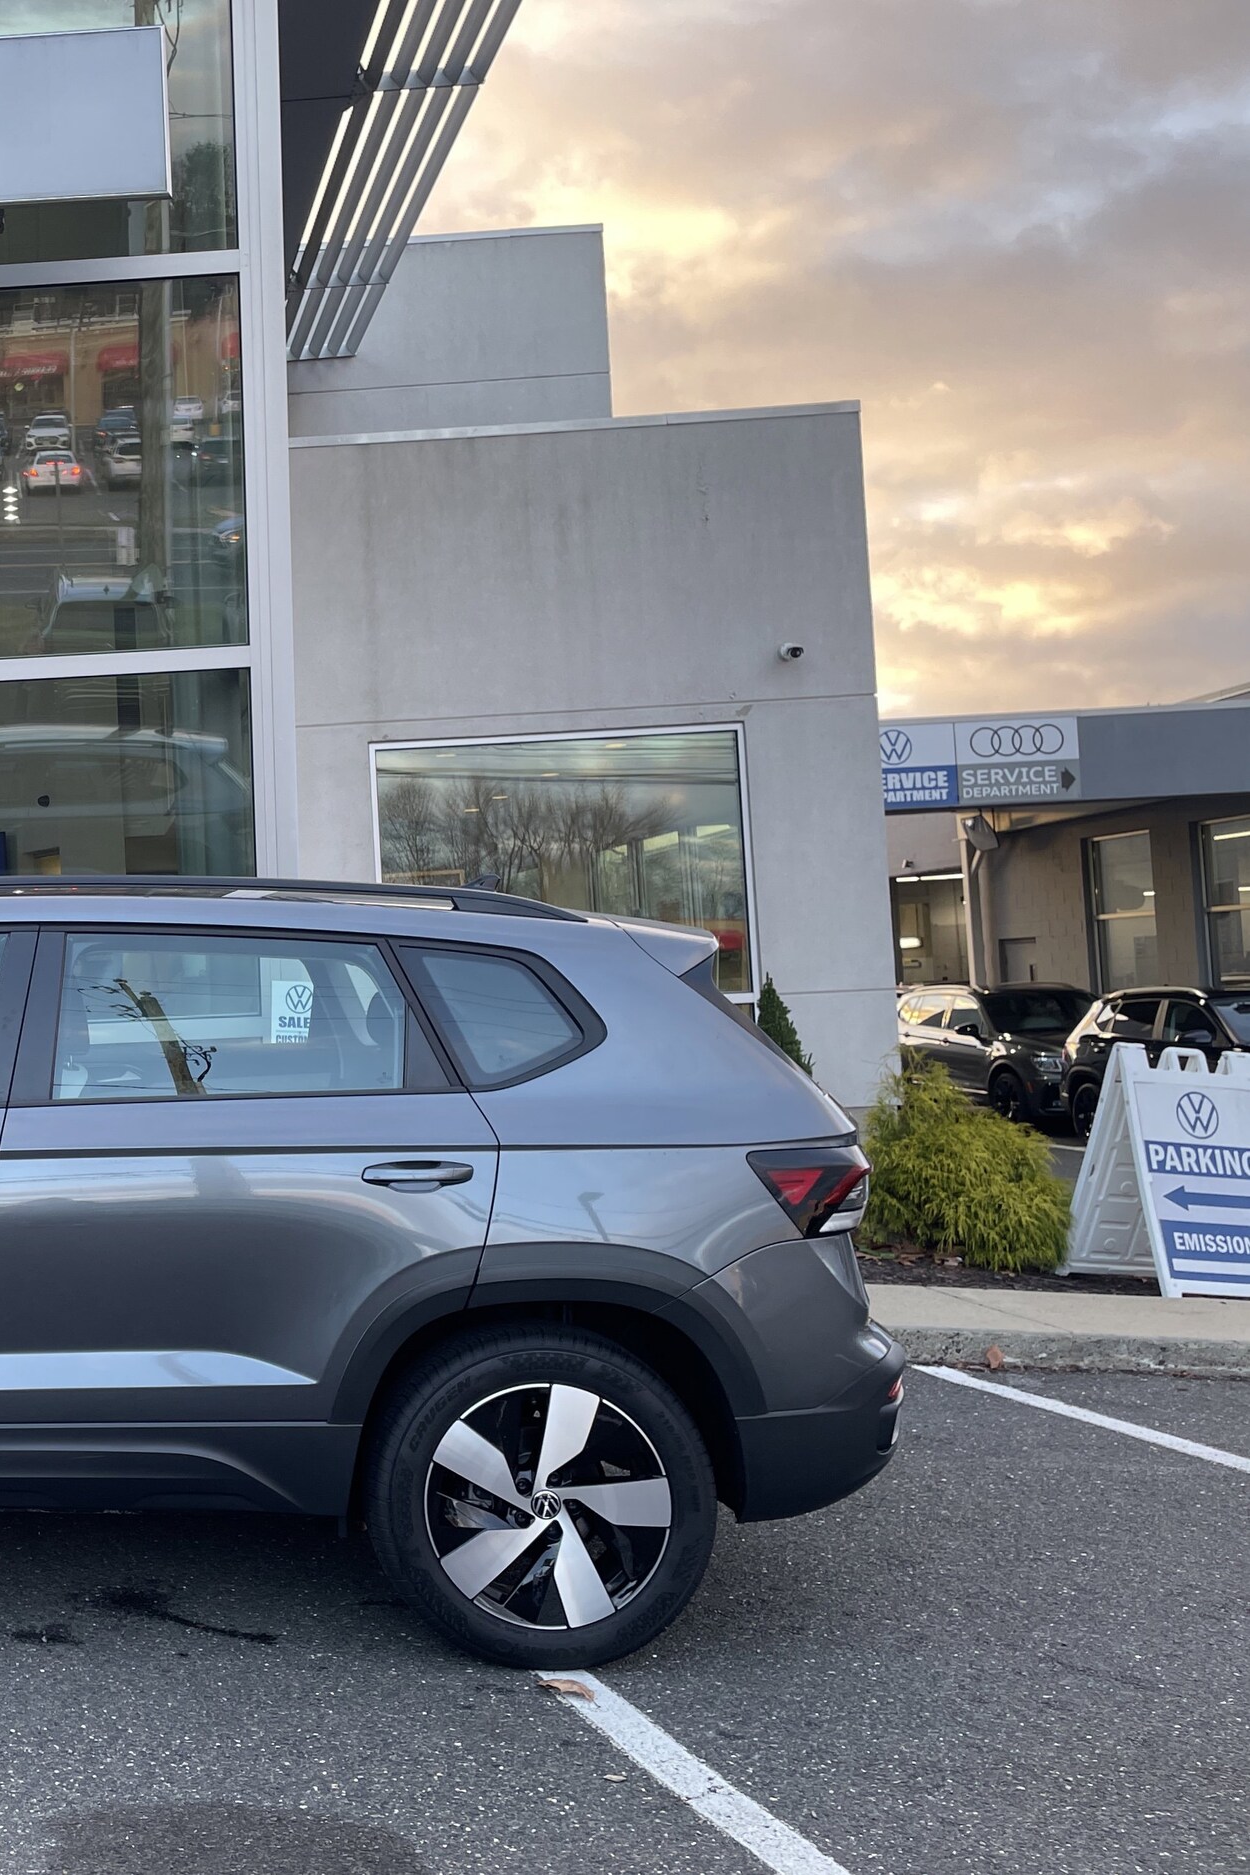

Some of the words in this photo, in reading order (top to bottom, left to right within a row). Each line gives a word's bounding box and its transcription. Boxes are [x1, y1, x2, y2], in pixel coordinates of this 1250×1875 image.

[961, 765, 1058, 785] SERVICE
[962, 783, 1059, 799] DEPARTMENT
[278, 1016, 310, 1028] SALE
[409, 1375, 473, 1453] CRUGEN
